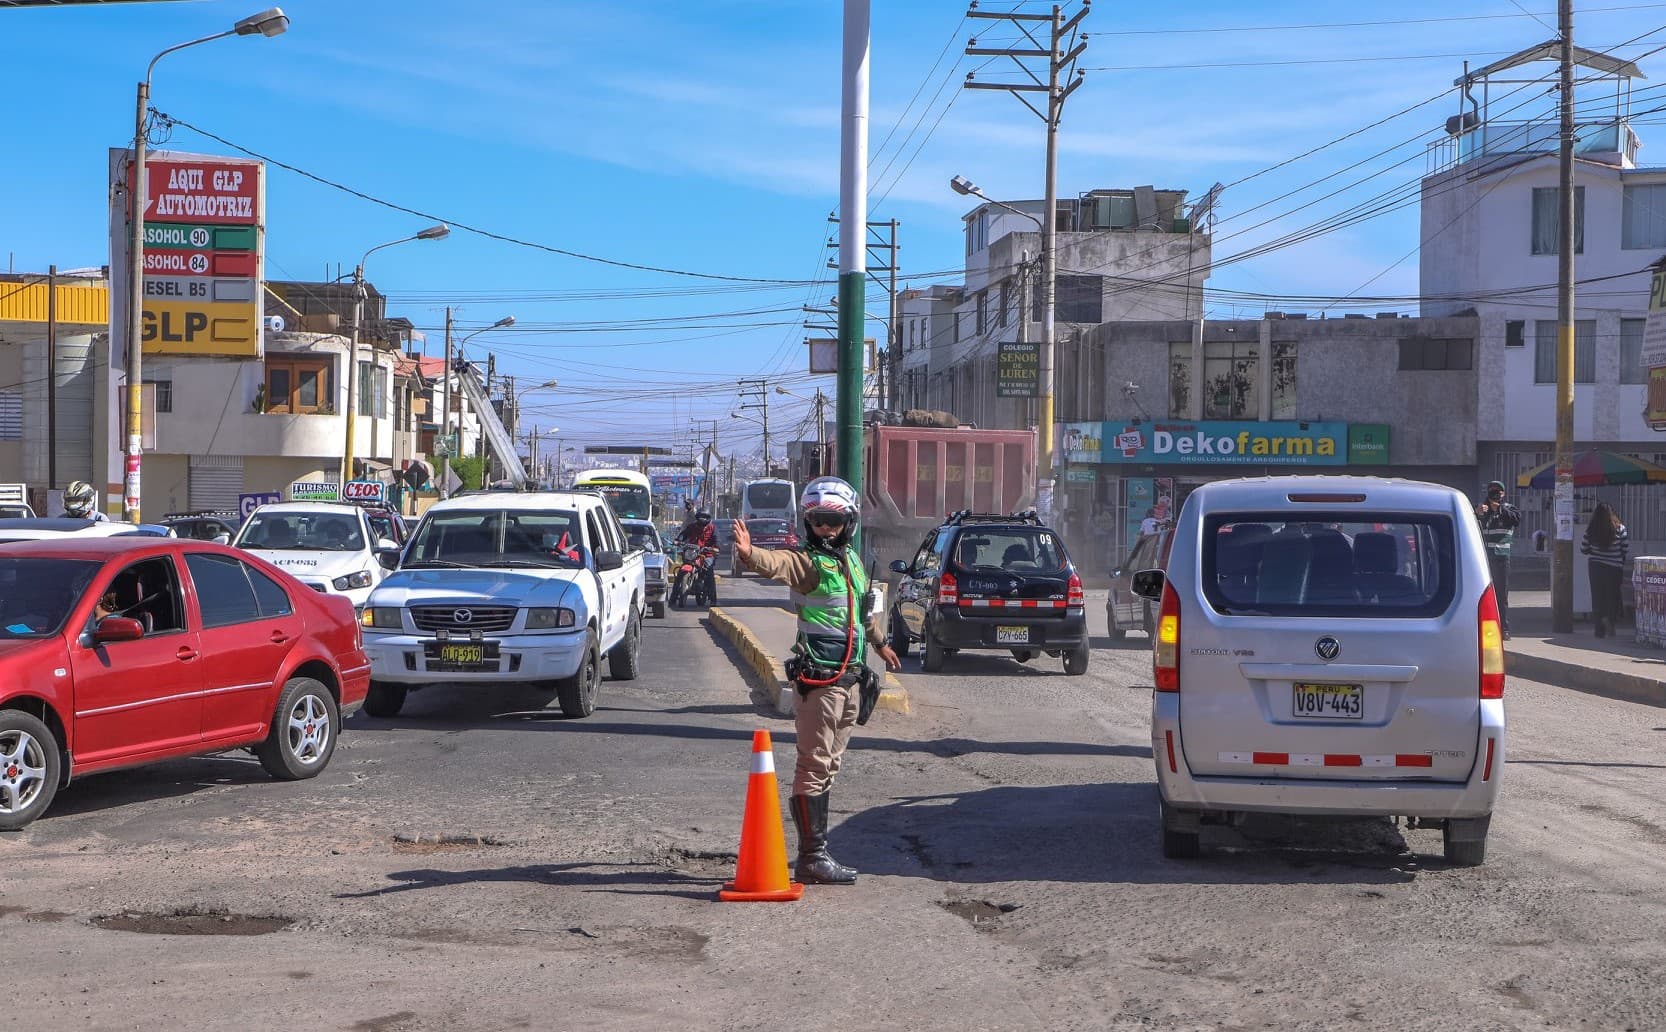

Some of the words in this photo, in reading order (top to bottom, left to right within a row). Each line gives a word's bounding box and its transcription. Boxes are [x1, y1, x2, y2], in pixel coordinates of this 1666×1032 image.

[168, 168, 204, 193] AQUI
[213, 170, 243, 192] GLP
[156, 194, 252, 217] AUTOMOTRIZ
[142, 228, 188, 244] ASOHOL
[193, 231, 206, 245] 90
[142, 254, 187, 270] ASOHOL
[191, 256, 205, 271] 84
[142, 281, 183, 296] IESEL
[189, 282, 206, 297] B5
[141, 310, 209, 343] GLP
[1000, 368, 1037, 379] LUREN
[345, 482, 381, 497] CEOS
[1039, 533, 1052, 545] 09
[1315, 686, 1341, 694] PERU
[1296, 692, 1360, 714] V8V-443
